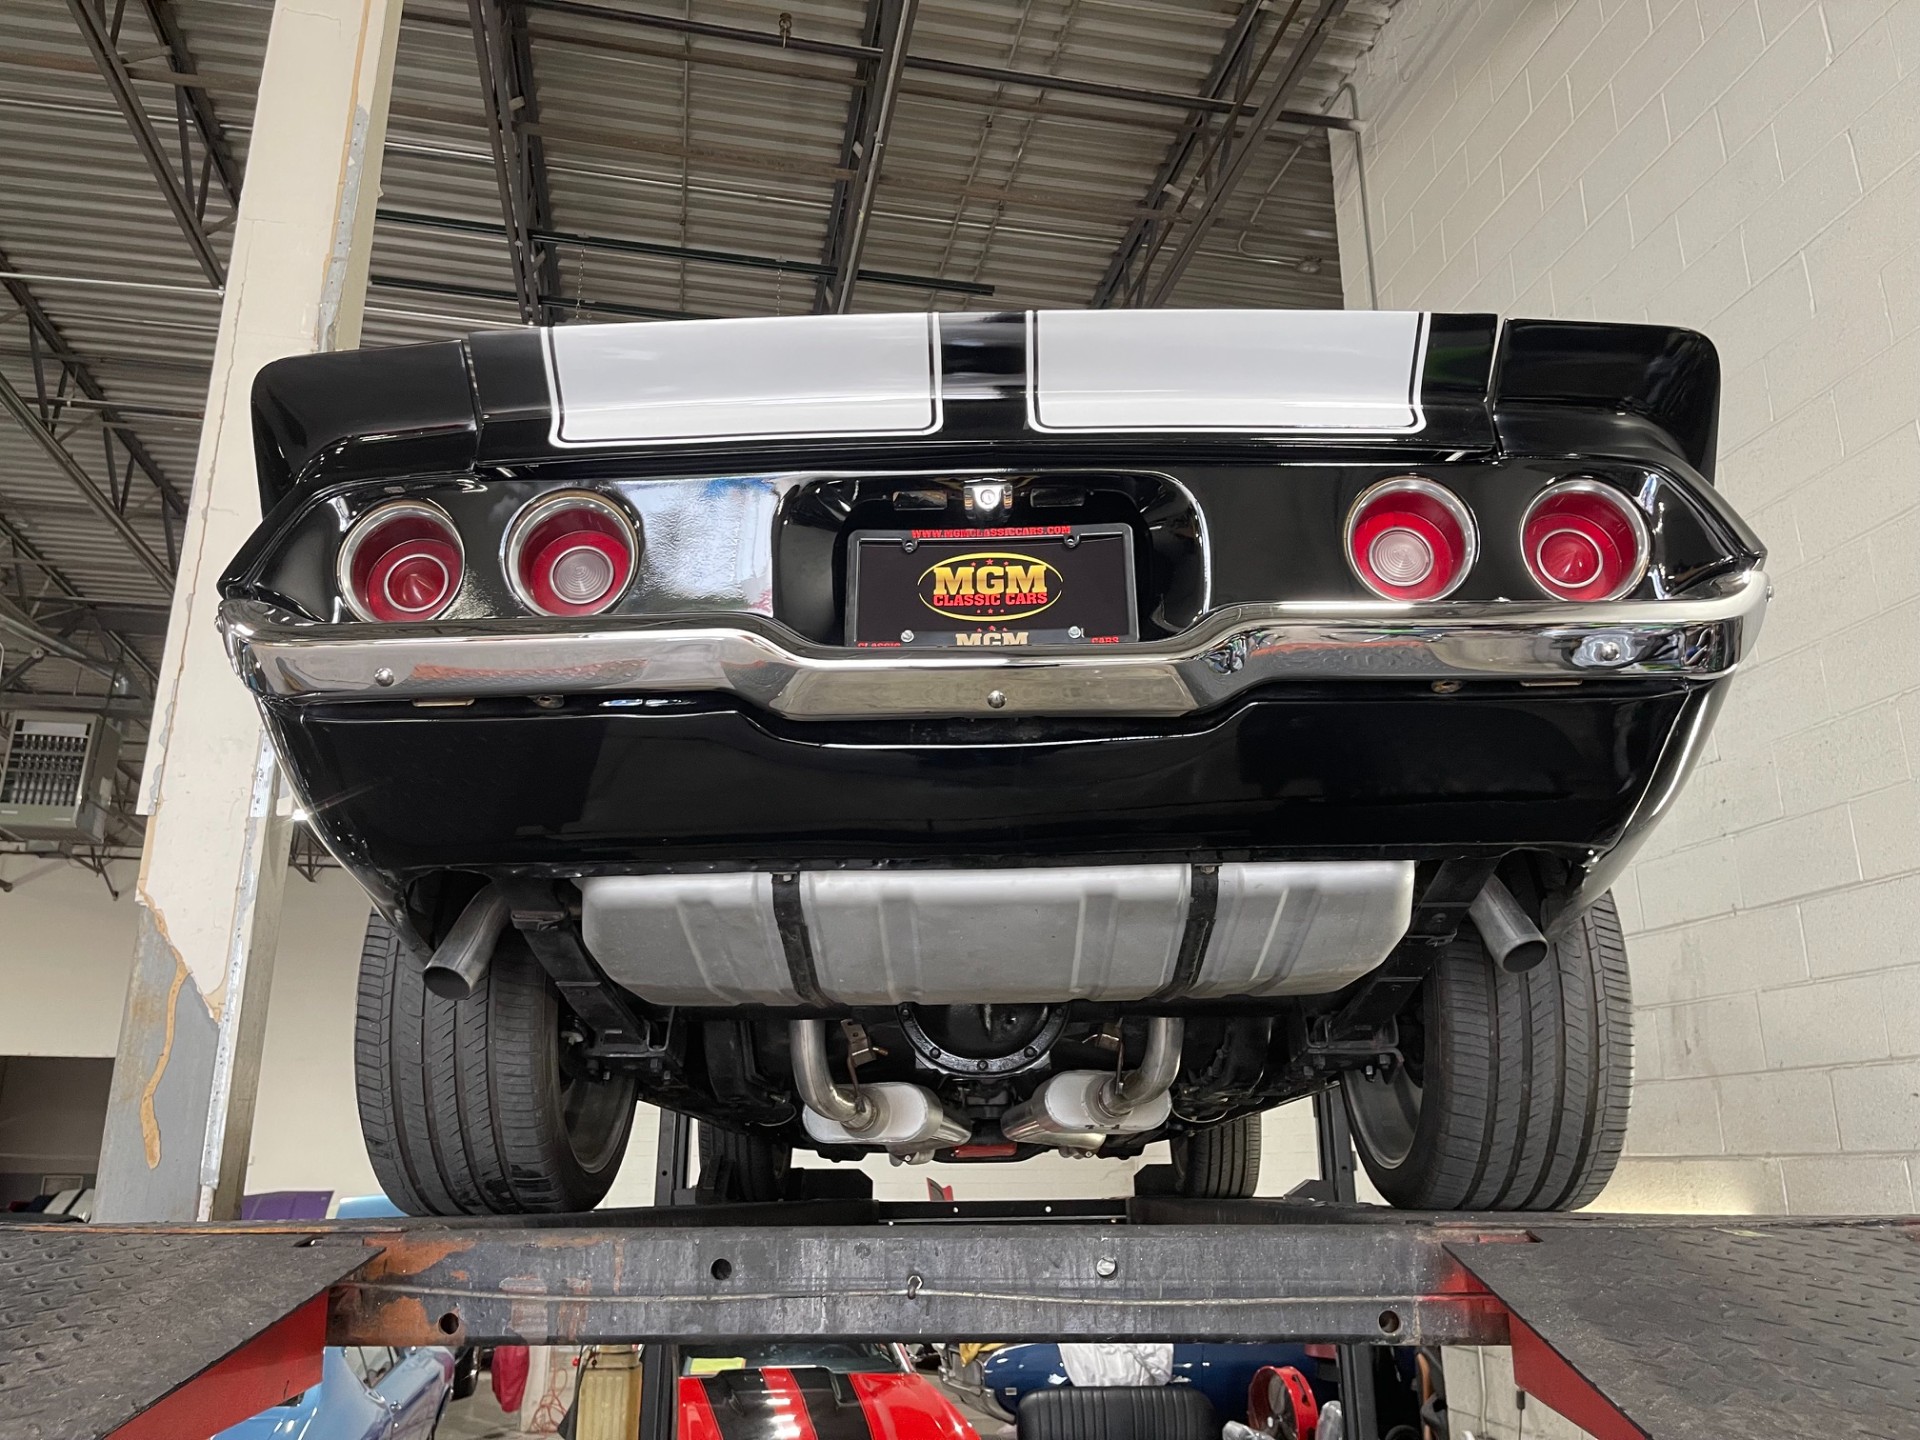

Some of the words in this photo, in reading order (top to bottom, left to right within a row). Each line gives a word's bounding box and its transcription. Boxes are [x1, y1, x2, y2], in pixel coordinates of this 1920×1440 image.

[911, 526, 1071, 539] WWW.MGMCLASSICCARS.COM
[933, 565, 1047, 595] MGM
[933, 594, 1001, 607] CLASSIC
[1005, 593, 1048, 605] CARS
